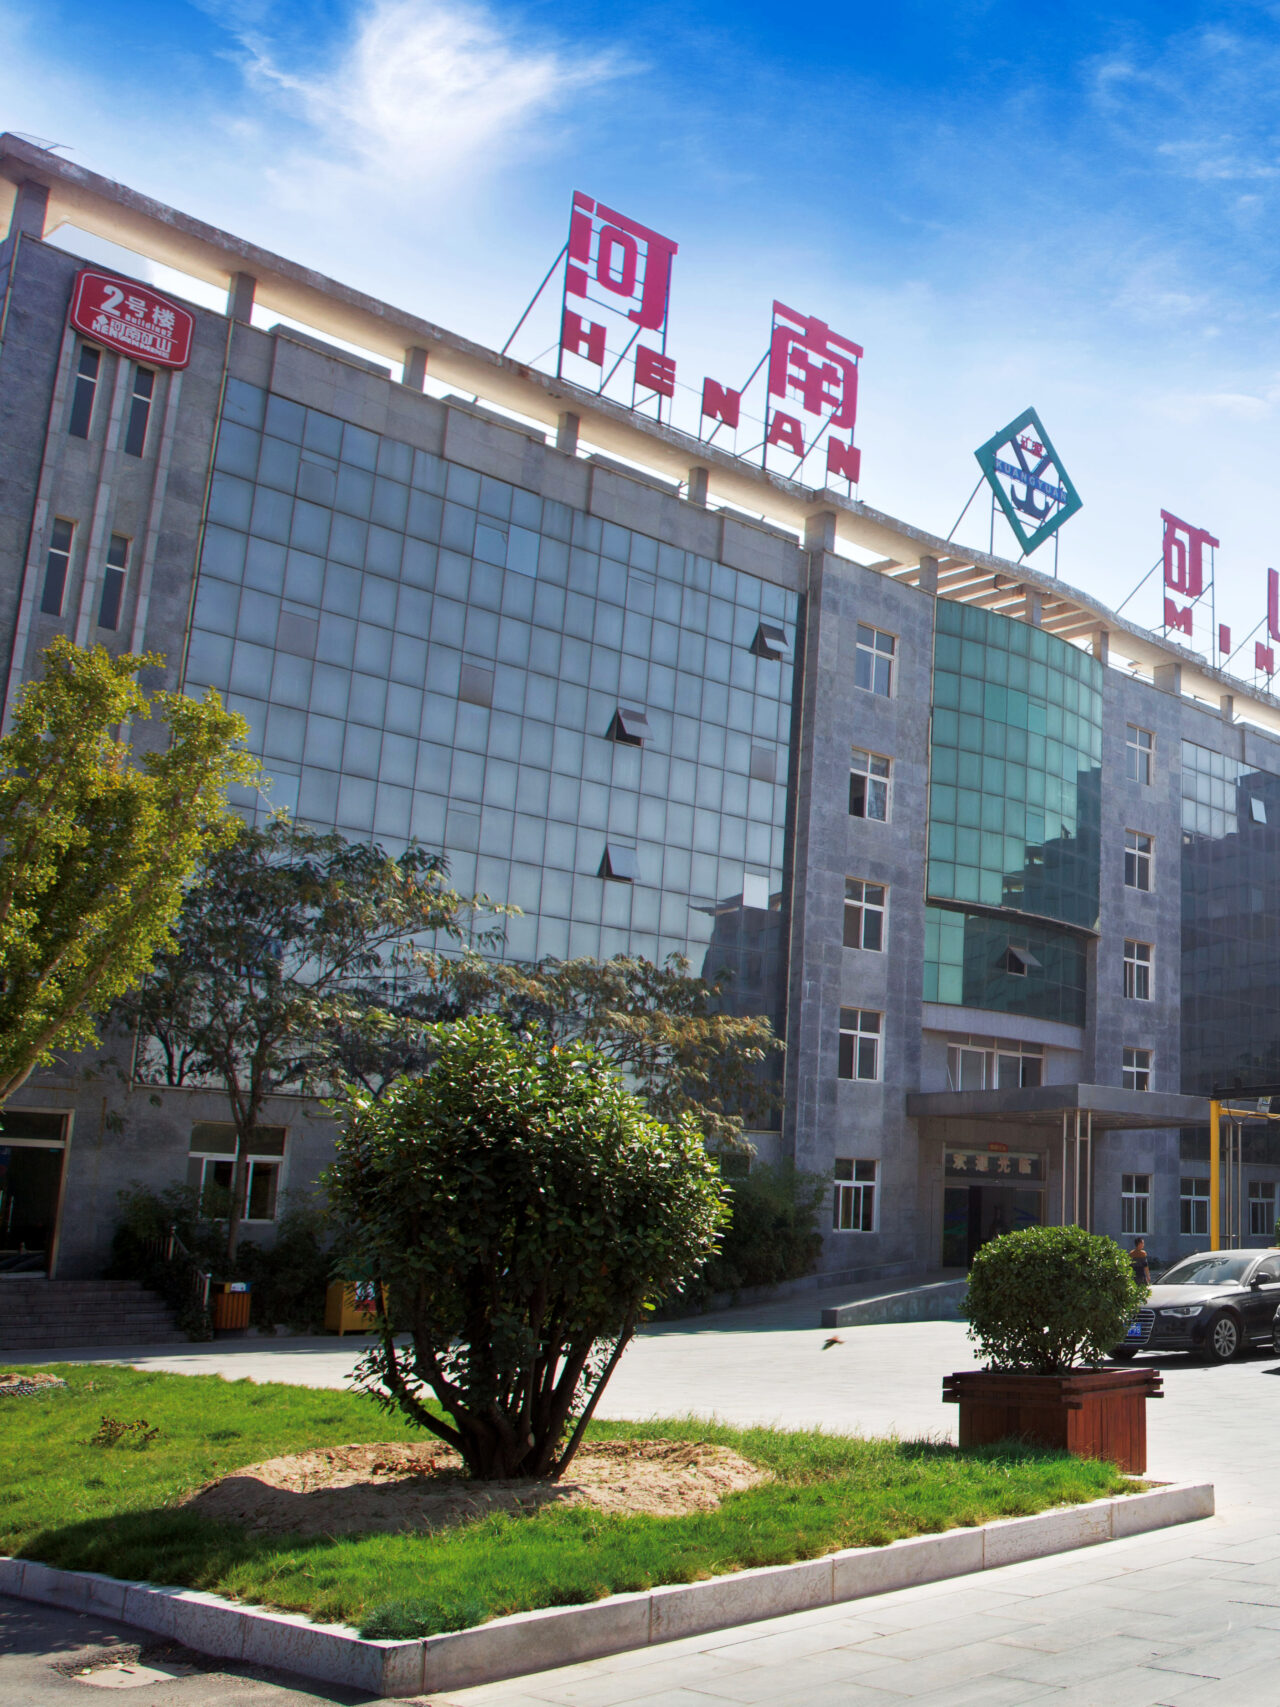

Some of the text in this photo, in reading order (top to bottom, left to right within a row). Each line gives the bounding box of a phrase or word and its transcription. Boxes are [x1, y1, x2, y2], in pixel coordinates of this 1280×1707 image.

[100, 284, 175, 331] 2号楼
[565, 190, 864, 430] 河南
[561, 309, 861, 484] HENAN
[995, 459, 1067, 503] KUANGYUAN
